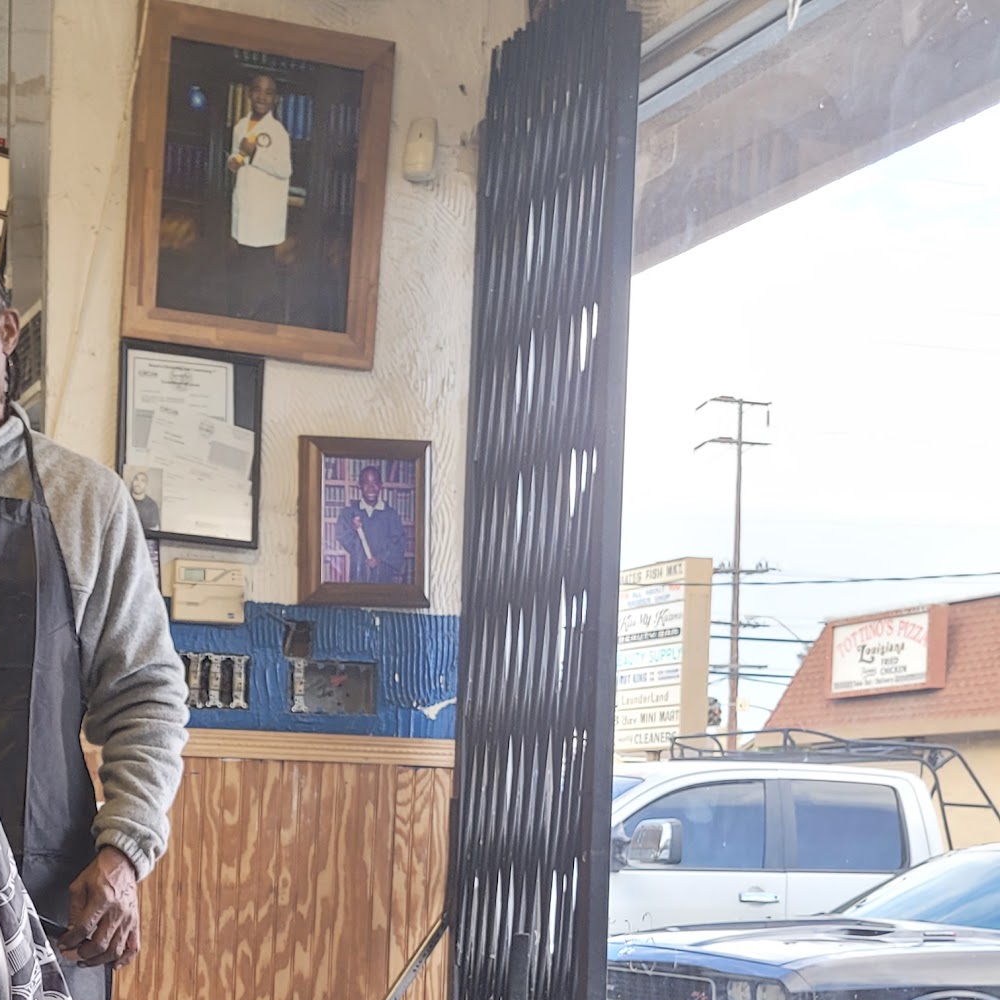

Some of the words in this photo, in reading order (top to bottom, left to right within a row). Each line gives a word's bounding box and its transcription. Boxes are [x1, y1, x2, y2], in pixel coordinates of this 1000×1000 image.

[646, 567, 662, 580] FISH
[649, 647, 682, 663] SUPPLY
[857, 641, 905, 664] Louisiana
[881, 657, 899, 666] FRIED
[880, 665, 907, 676] CHICKEN
[640, 713, 656, 724] MINI
[660, 710, 680, 723] MART
